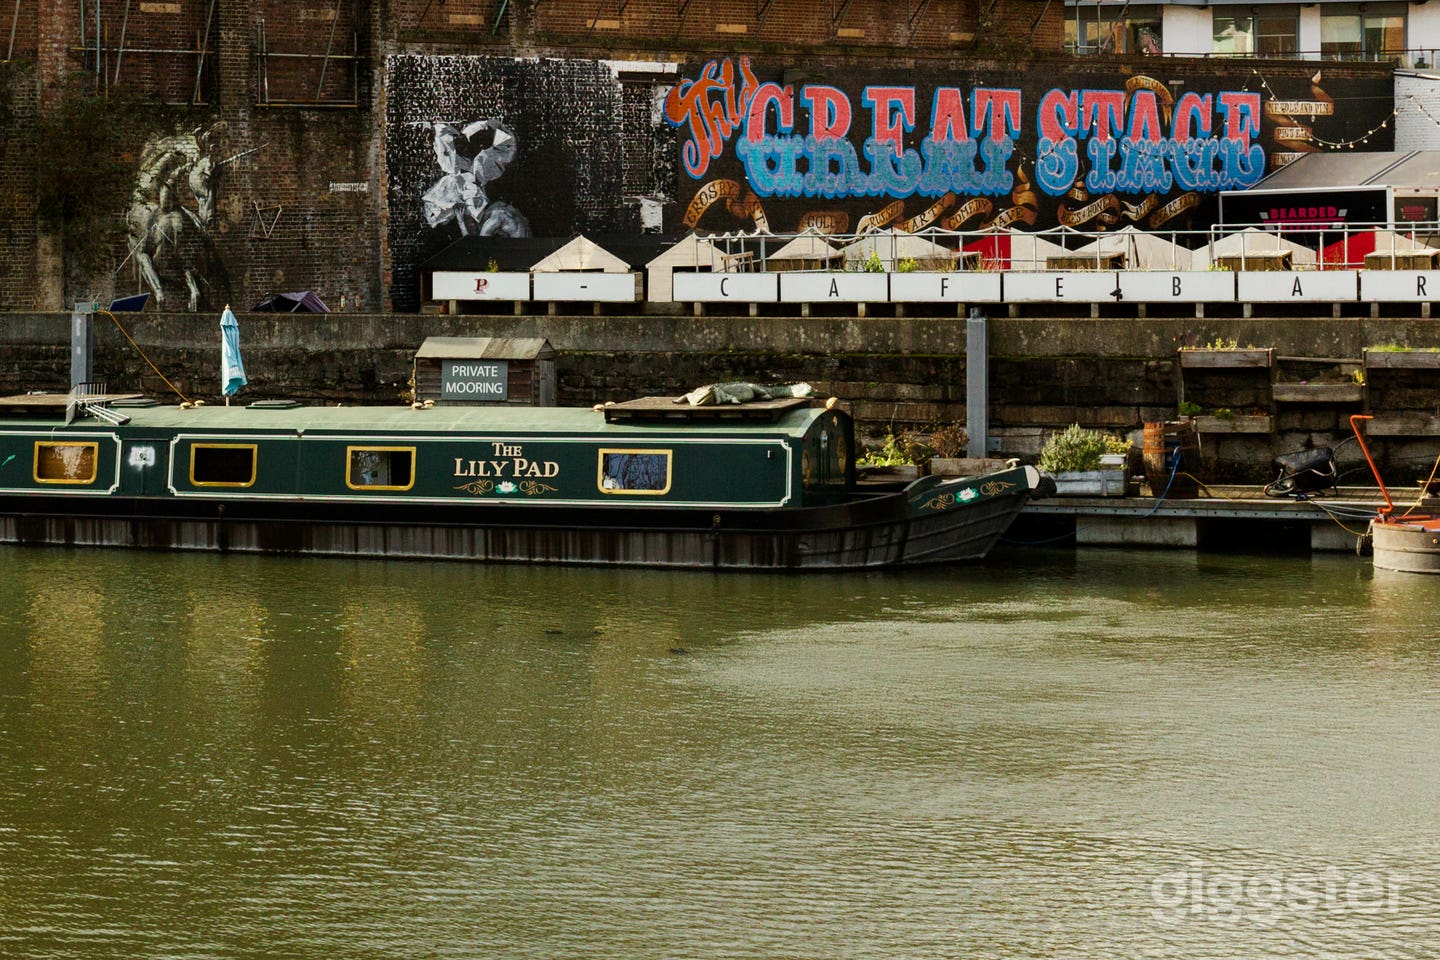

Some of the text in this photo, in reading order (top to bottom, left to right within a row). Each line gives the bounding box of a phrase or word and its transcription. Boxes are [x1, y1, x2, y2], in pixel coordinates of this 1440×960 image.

[663, 55, 1266, 198] This GREAT STAGE
[686, 181, 736, 224] CROSBY
[902, 198, 947, 233] HARTY
[947, 197, 989, 229] COMEDY
[1270, 206, 1337, 220] BEARDED
[452, 365, 498, 377] PRIVATE
[445, 381, 503, 394] MOORING
